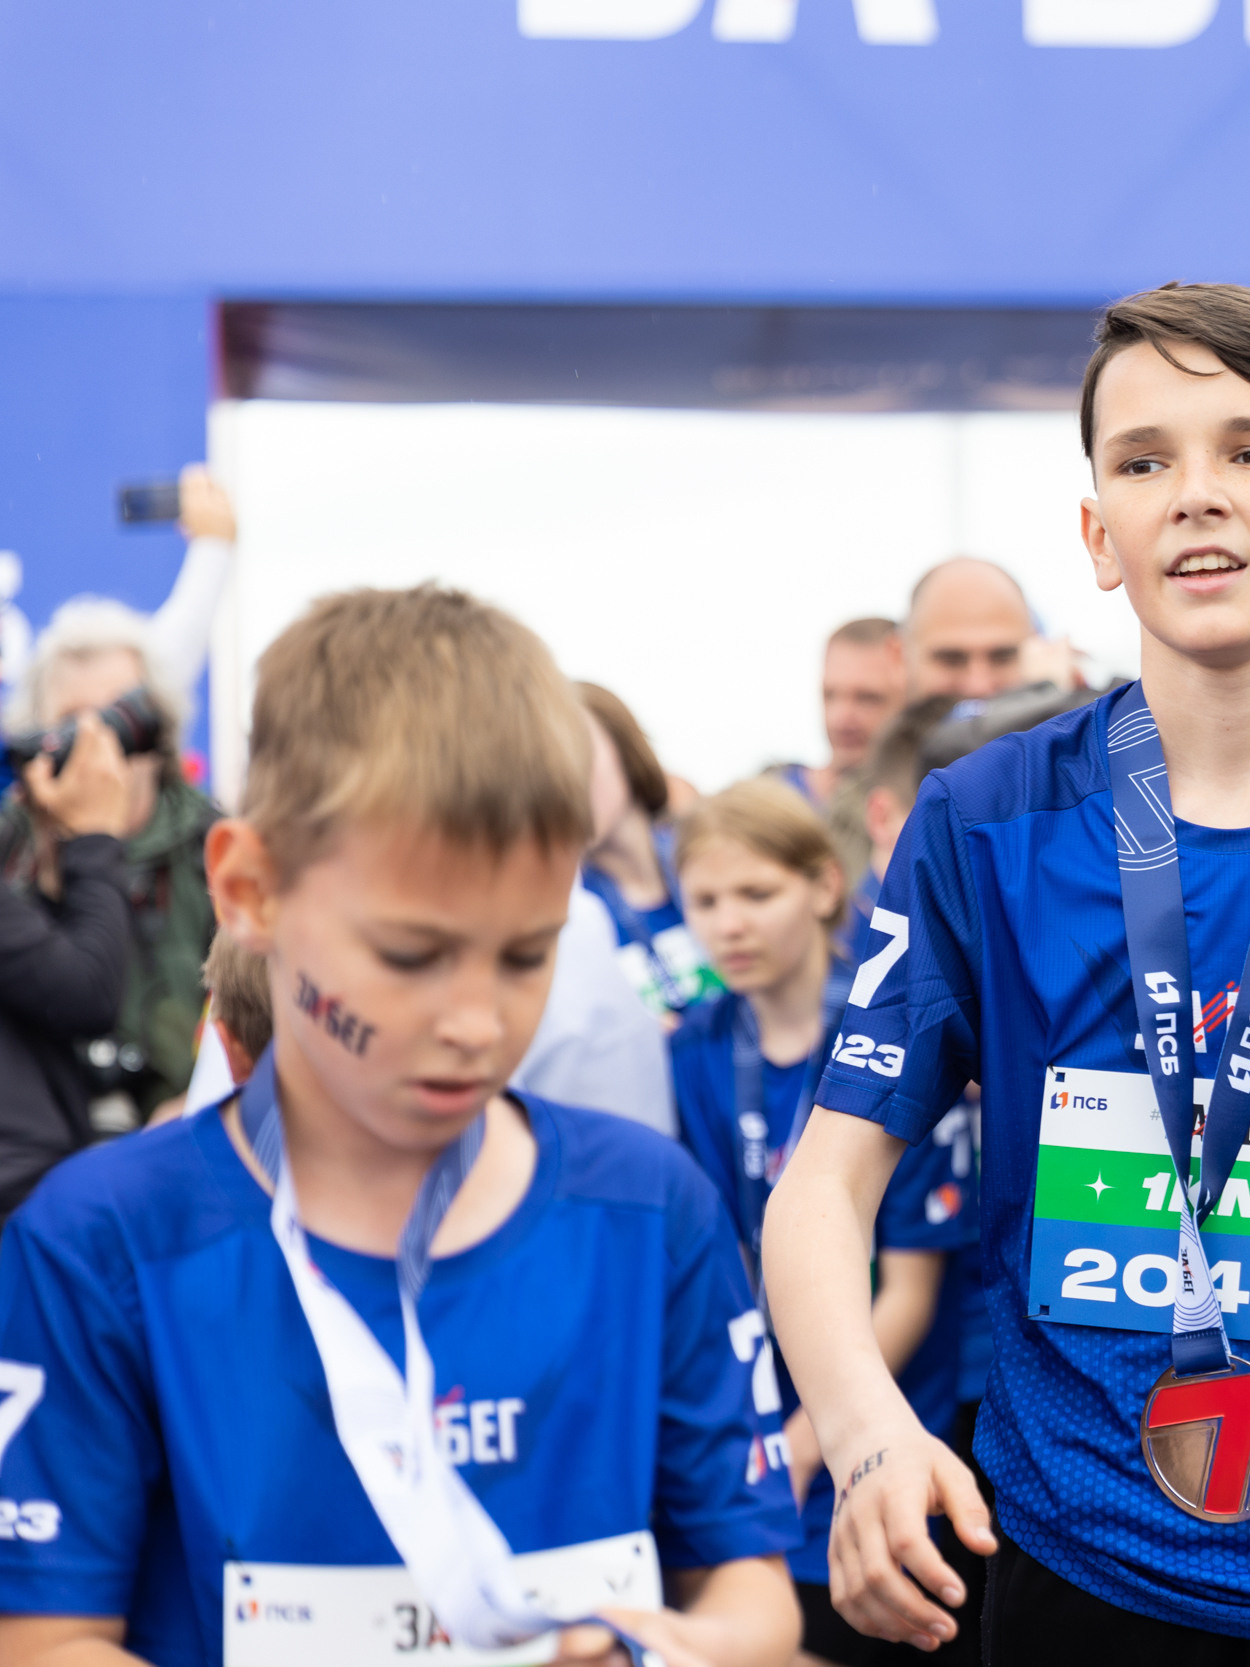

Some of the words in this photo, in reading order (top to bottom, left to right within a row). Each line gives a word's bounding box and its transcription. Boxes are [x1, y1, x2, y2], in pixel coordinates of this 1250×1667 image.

[848, 906, 909, 1009] 7
[1155, 1012, 1180, 1076] ПСБ
[1073, 1096, 1108, 1111] ПСБ
[434, 1396, 524, 1466] БЕГ
[834, 1447, 888, 1520] АБЕГ
